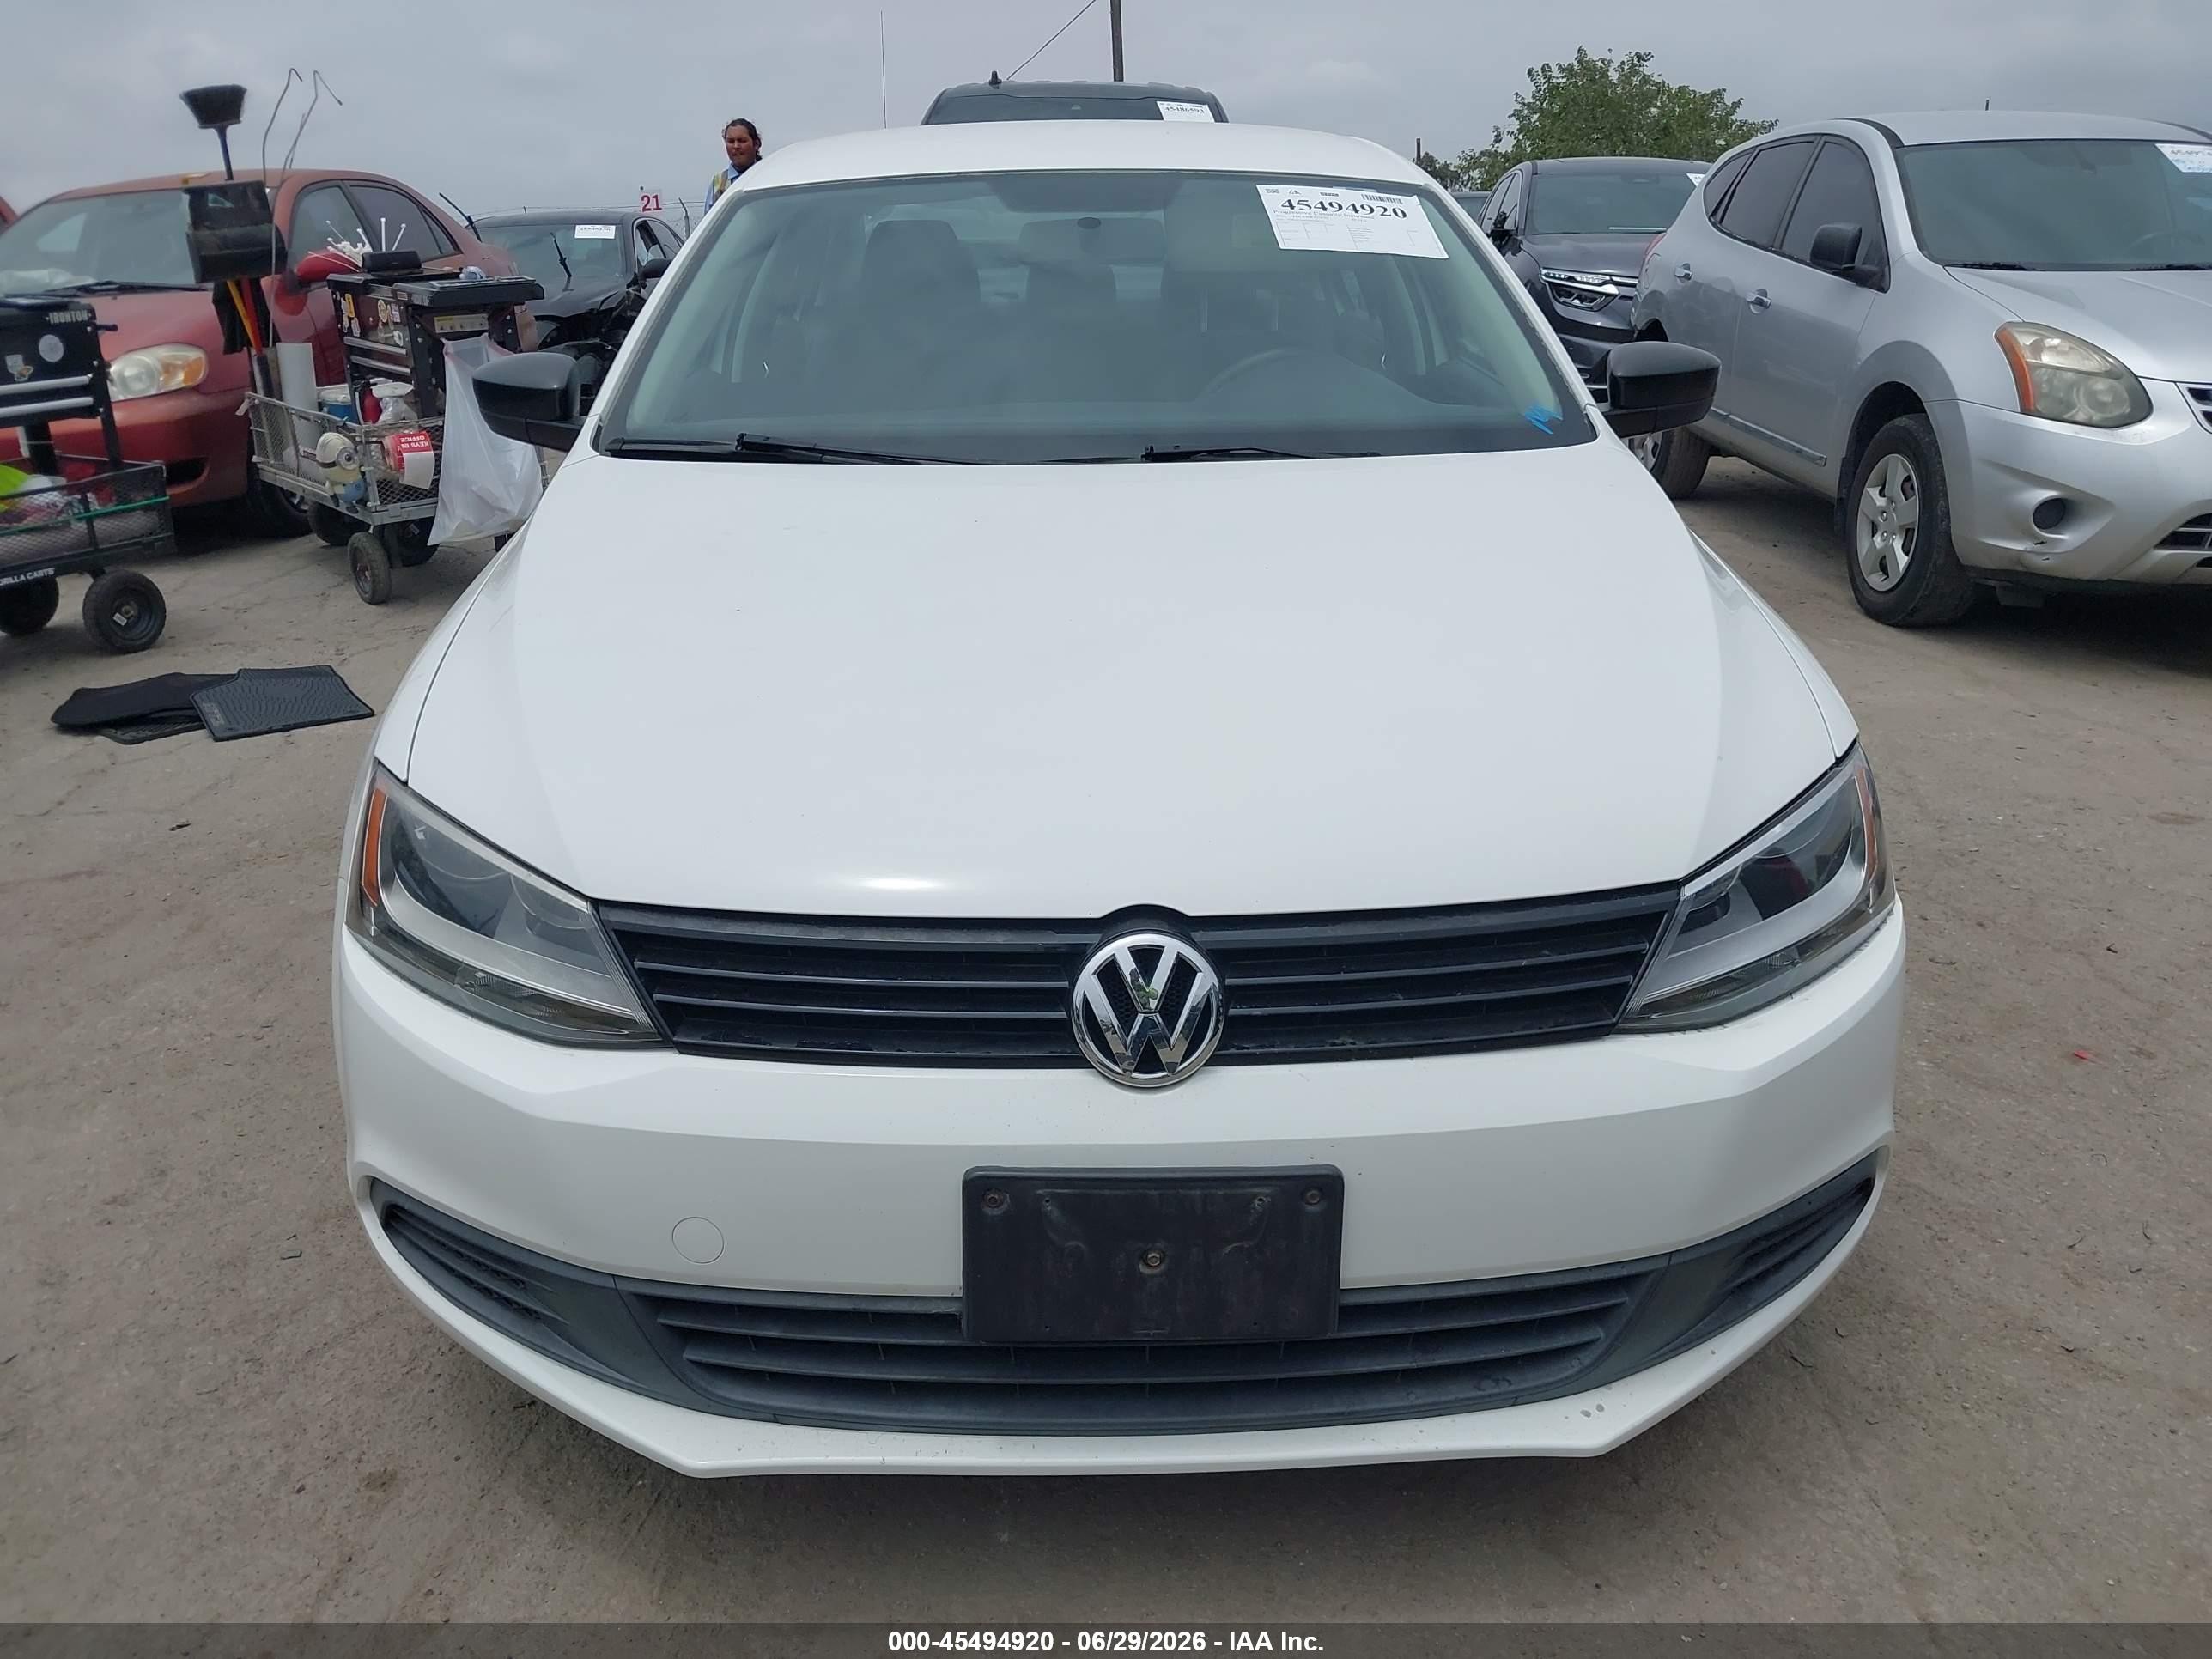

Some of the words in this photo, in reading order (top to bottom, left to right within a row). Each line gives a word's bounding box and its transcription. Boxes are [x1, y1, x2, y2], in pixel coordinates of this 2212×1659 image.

[641, 194, 662, 212] 21
[1281, 198, 1407, 219] 45494920
[49, 310, 88, 324] IRONTON
[27, 568, 55, 580] CARTS
